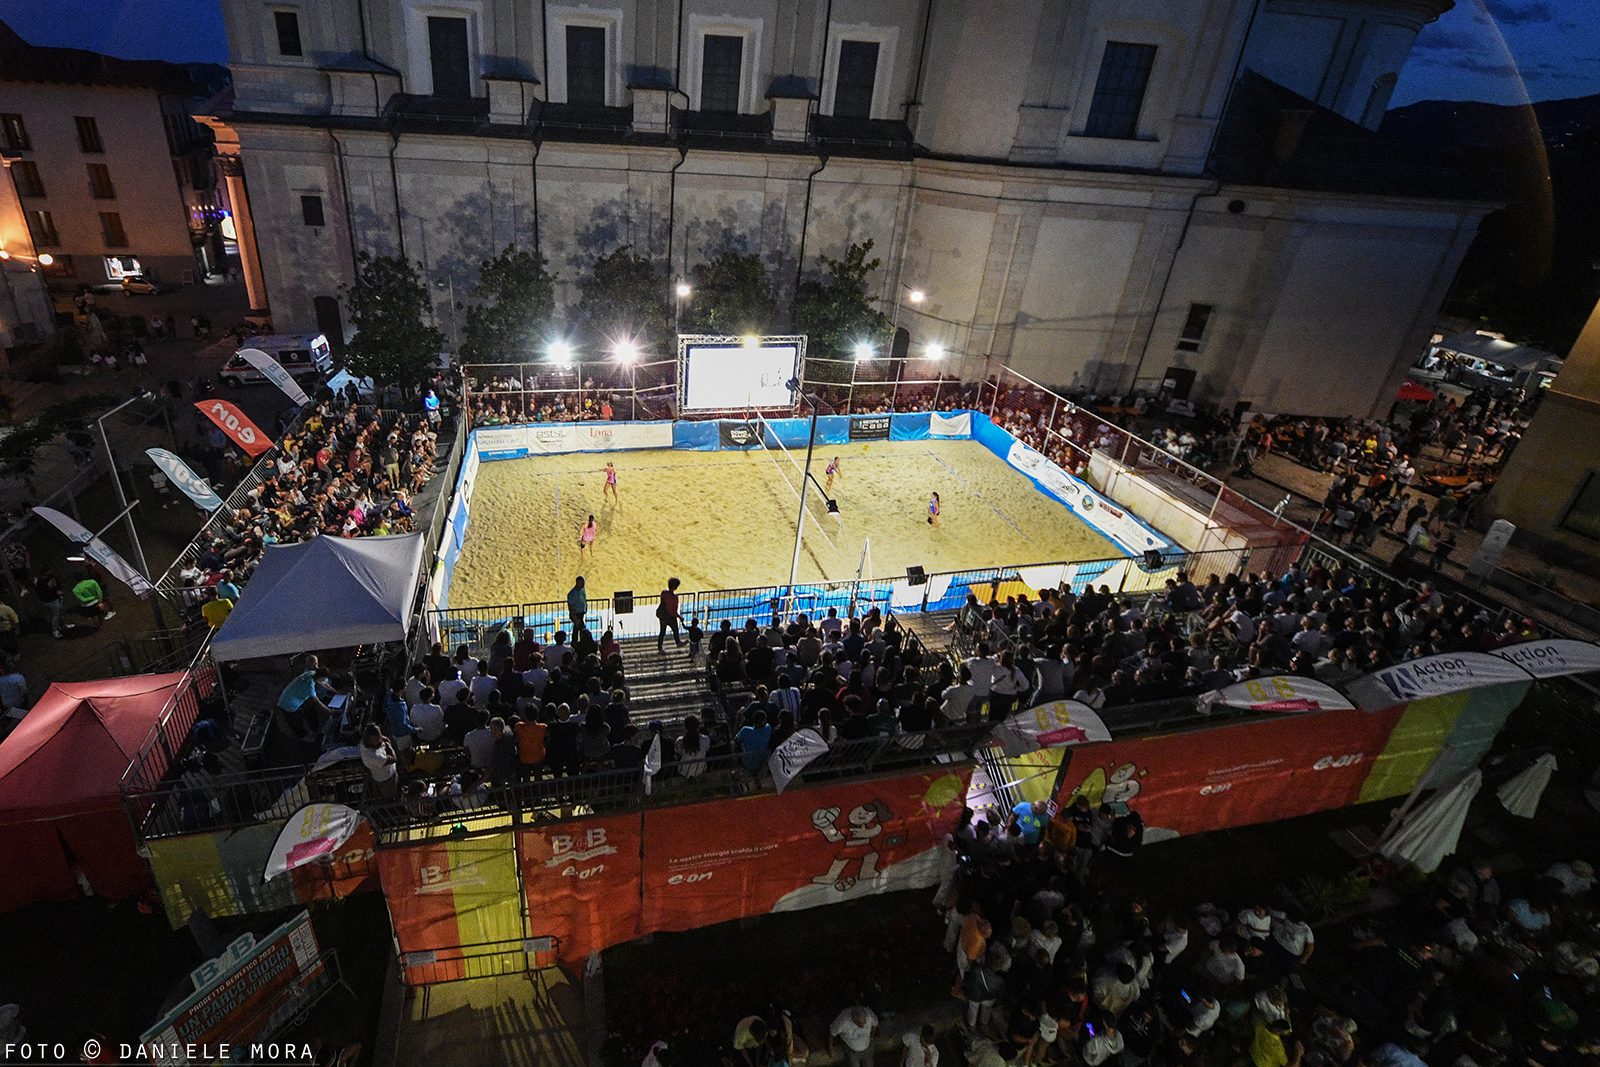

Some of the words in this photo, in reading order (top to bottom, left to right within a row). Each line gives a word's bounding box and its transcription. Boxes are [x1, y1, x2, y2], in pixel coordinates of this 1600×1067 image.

[590, 427, 613, 437] Lana
[1412, 657, 1467, 677] Action
[679, 853, 702, 863] nostra
[703, 849, 730, 859] energia
[178, 1014, 201, 1037] UN
[202, 980, 247, 1022] PARCO
[248, 944, 292, 983] GIOCHI
[184, 1000, 237, 1045] INCLUSIVO
[246, 955, 293, 997] VERBANIA
[188, 985, 225, 1016] PROGETTO
[225, 959, 258, 988] BENEFICO
[258, 944, 277, 962] 2023
